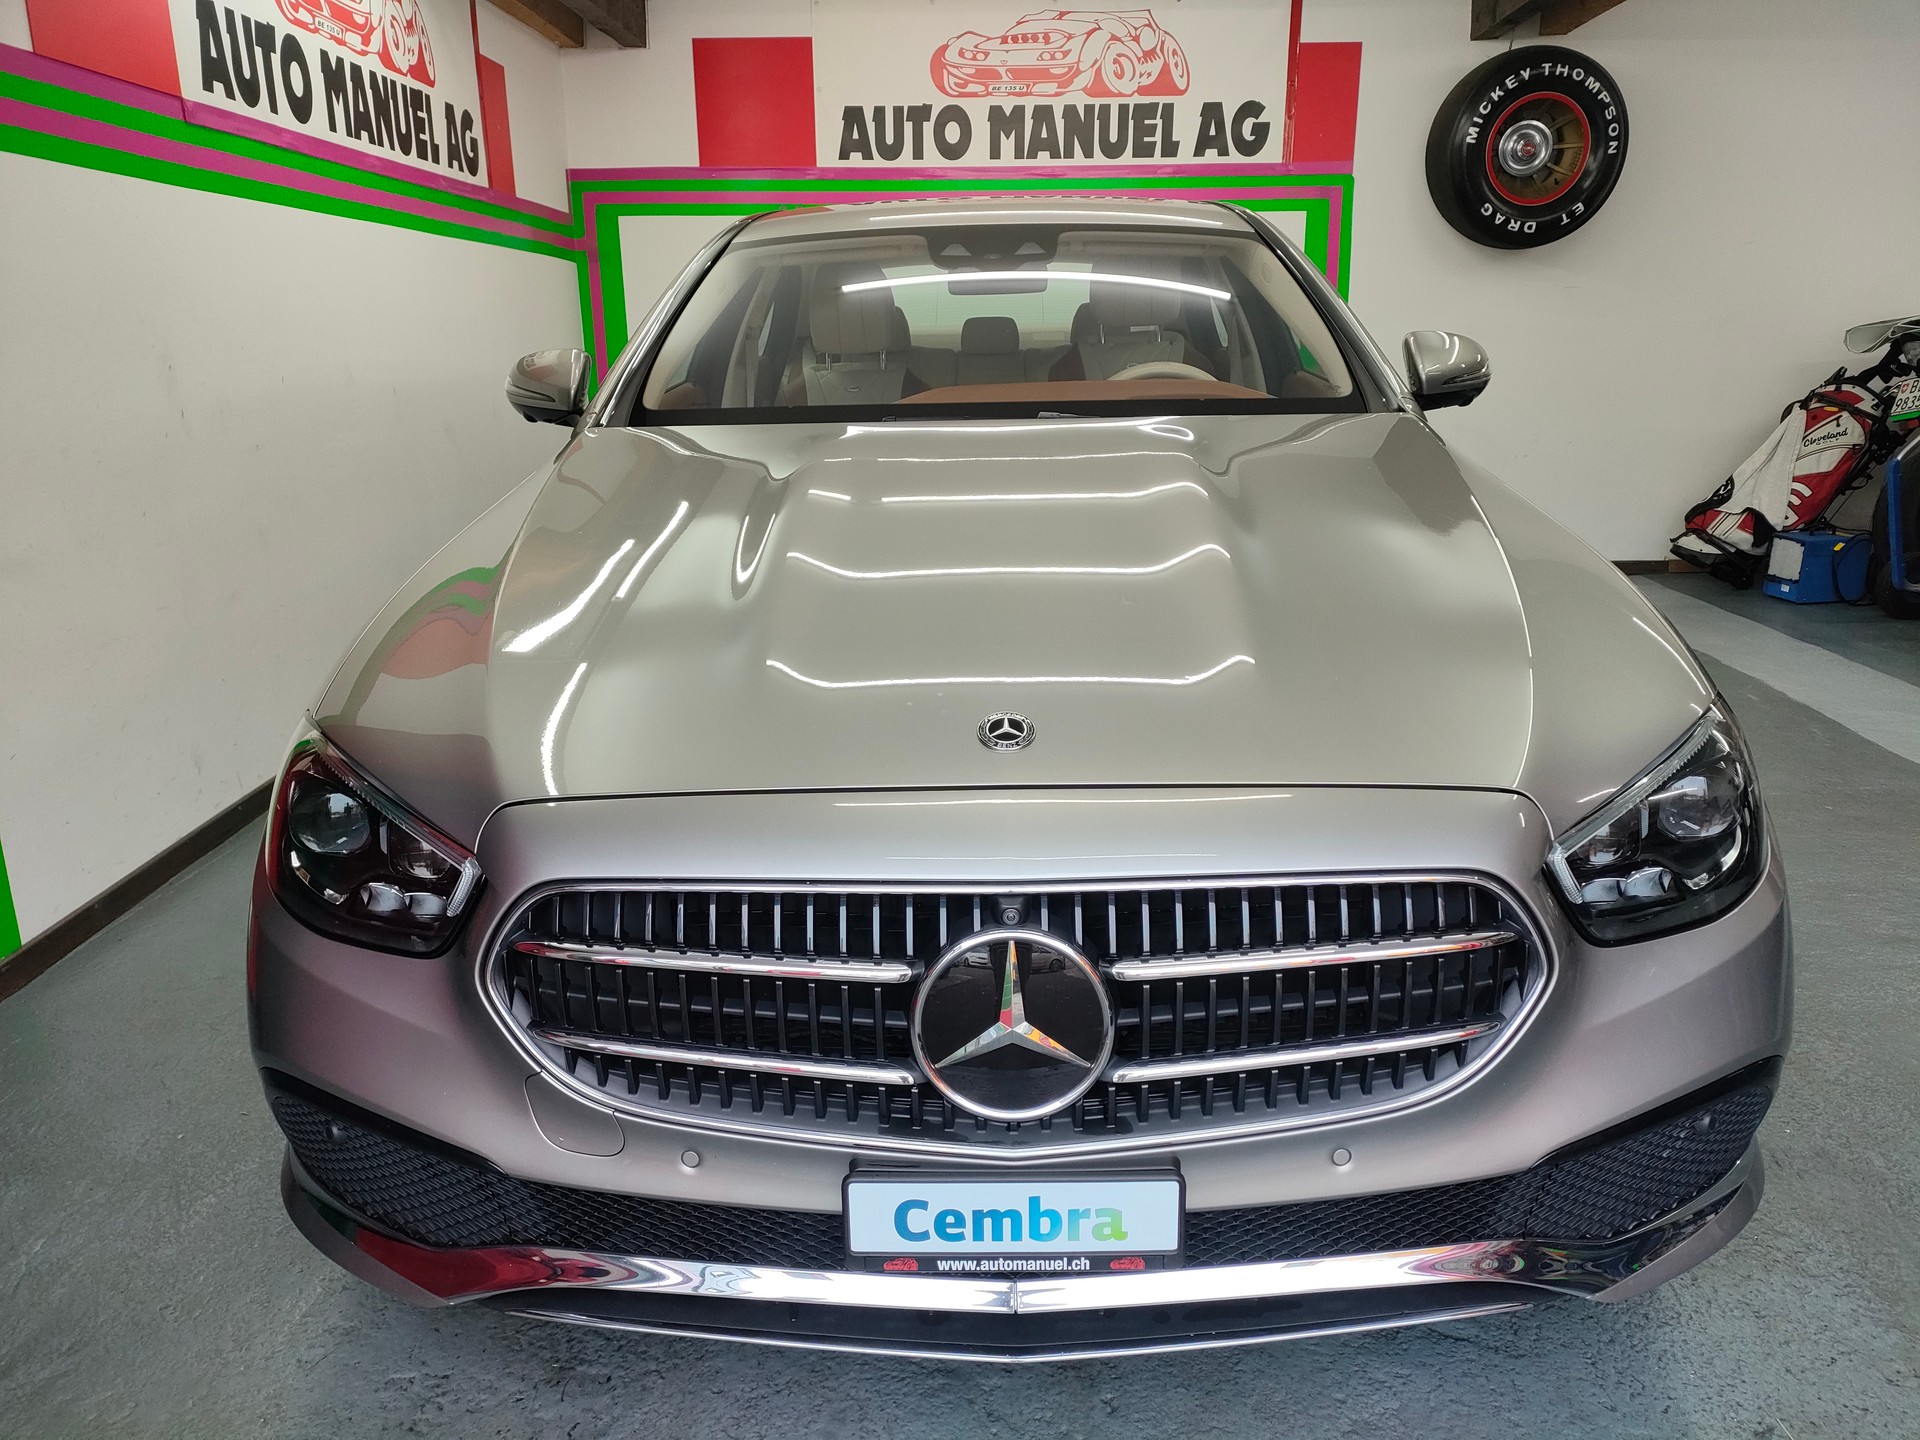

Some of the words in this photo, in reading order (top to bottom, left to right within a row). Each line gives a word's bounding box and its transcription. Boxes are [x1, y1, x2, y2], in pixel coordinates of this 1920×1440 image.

[195, 0, 314, 125] AUTO
[319, 48, 440, 166] MANUEL
[444, 101, 480, 178] AG
[1466, 67, 1531, 144] MICKEY
[1541, 63, 1620, 155] THOMPSON
[838, 103, 973, 161] AUTO
[987, 102, 1181, 160] MANUEL
[1193, 100, 1271, 157] AG
[1480, 202, 1537, 234] DRAG
[1560, 202, 1585, 226] ET
[1803, 427, 1849, 448] Cleveland
[893, 1195, 1129, 1243] Cembra
[936, 1257, 1091, 1272] www.automanuel.ch
